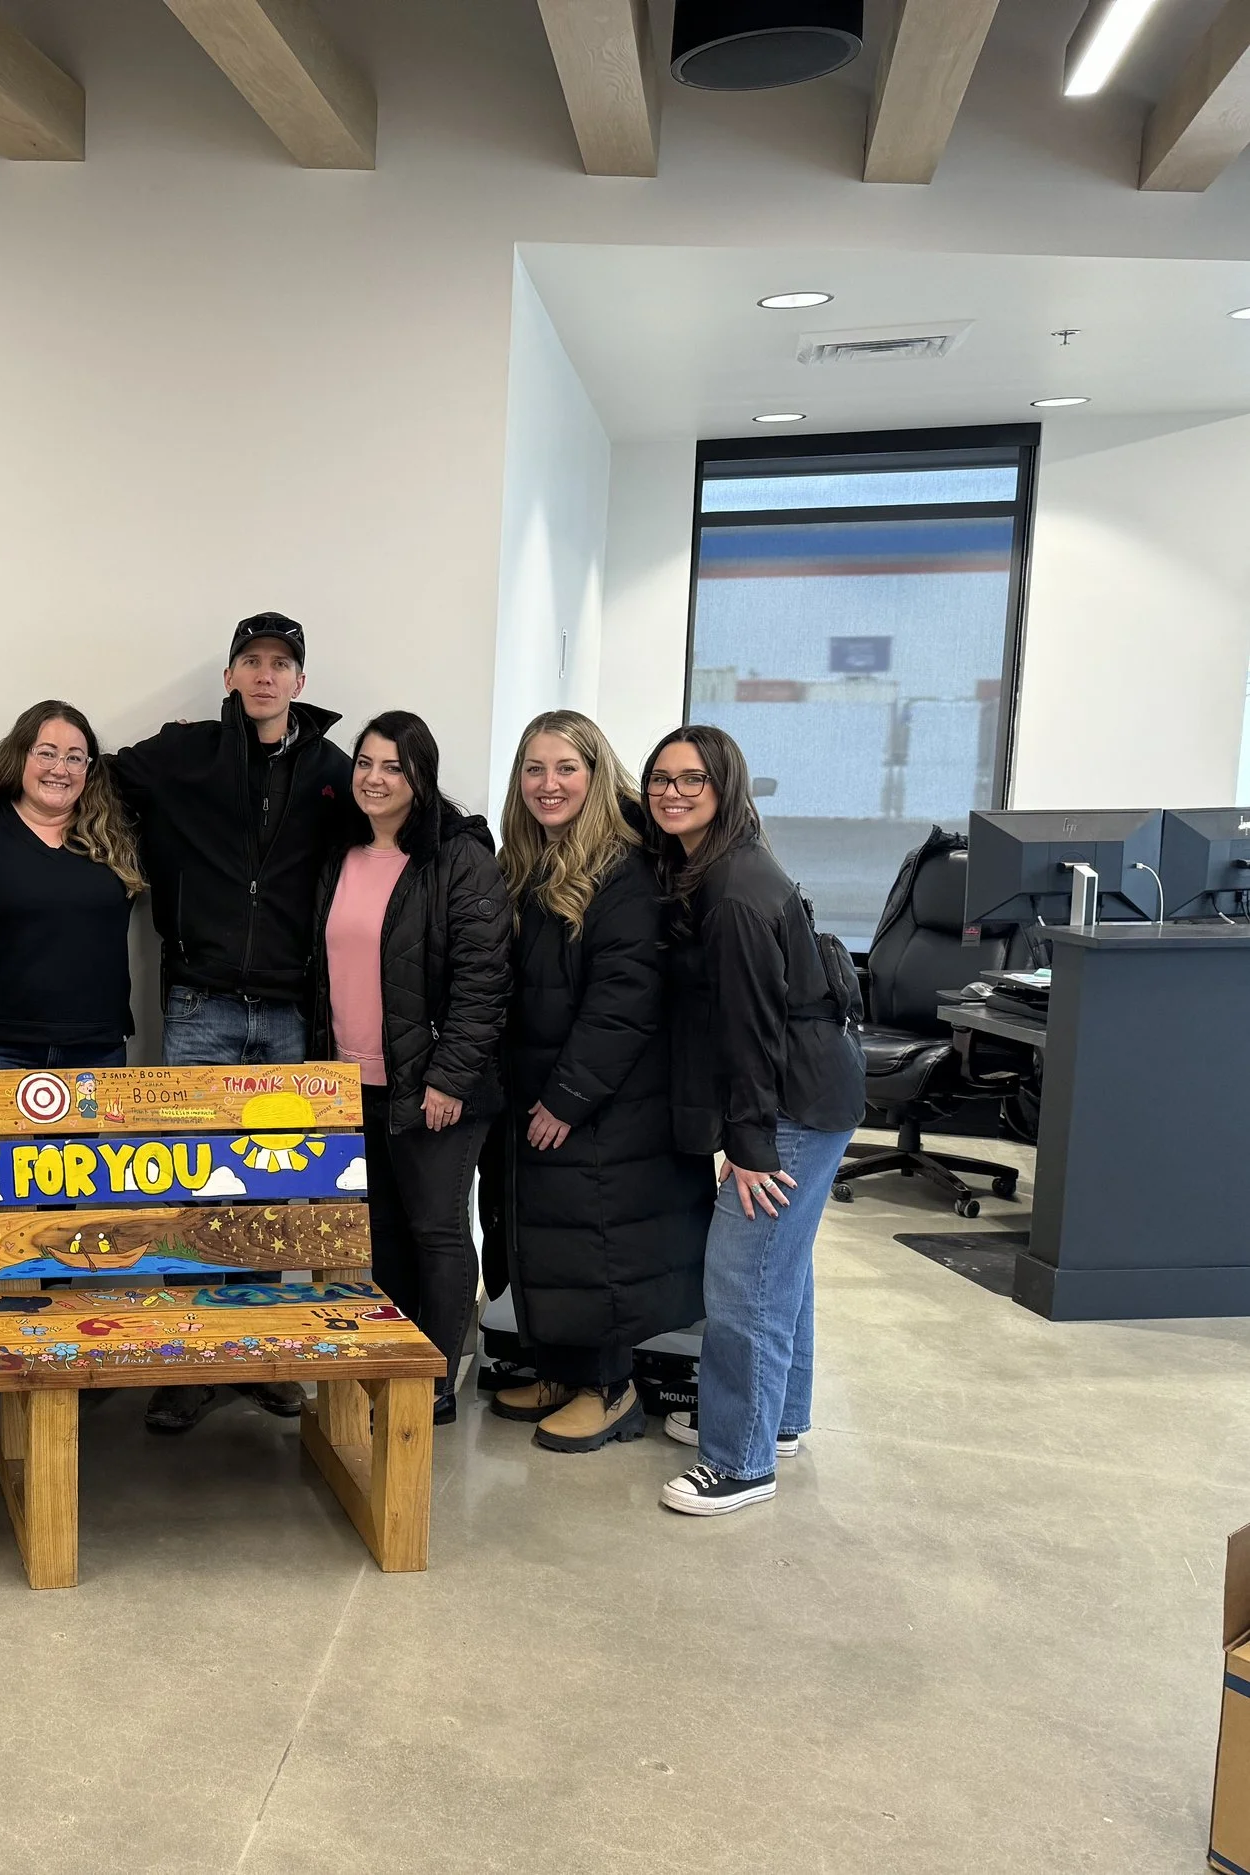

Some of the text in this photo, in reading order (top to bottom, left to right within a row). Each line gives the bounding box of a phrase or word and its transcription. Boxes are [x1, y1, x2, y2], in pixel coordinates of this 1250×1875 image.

[140, 1070, 171, 1079] BOOM
[222, 1074, 338, 1096] THANK YOU
[133, 1087, 188, 1103] BOOM!
[12, 1143, 97, 1199] FOR
[97, 1141, 212, 1195] YOU
